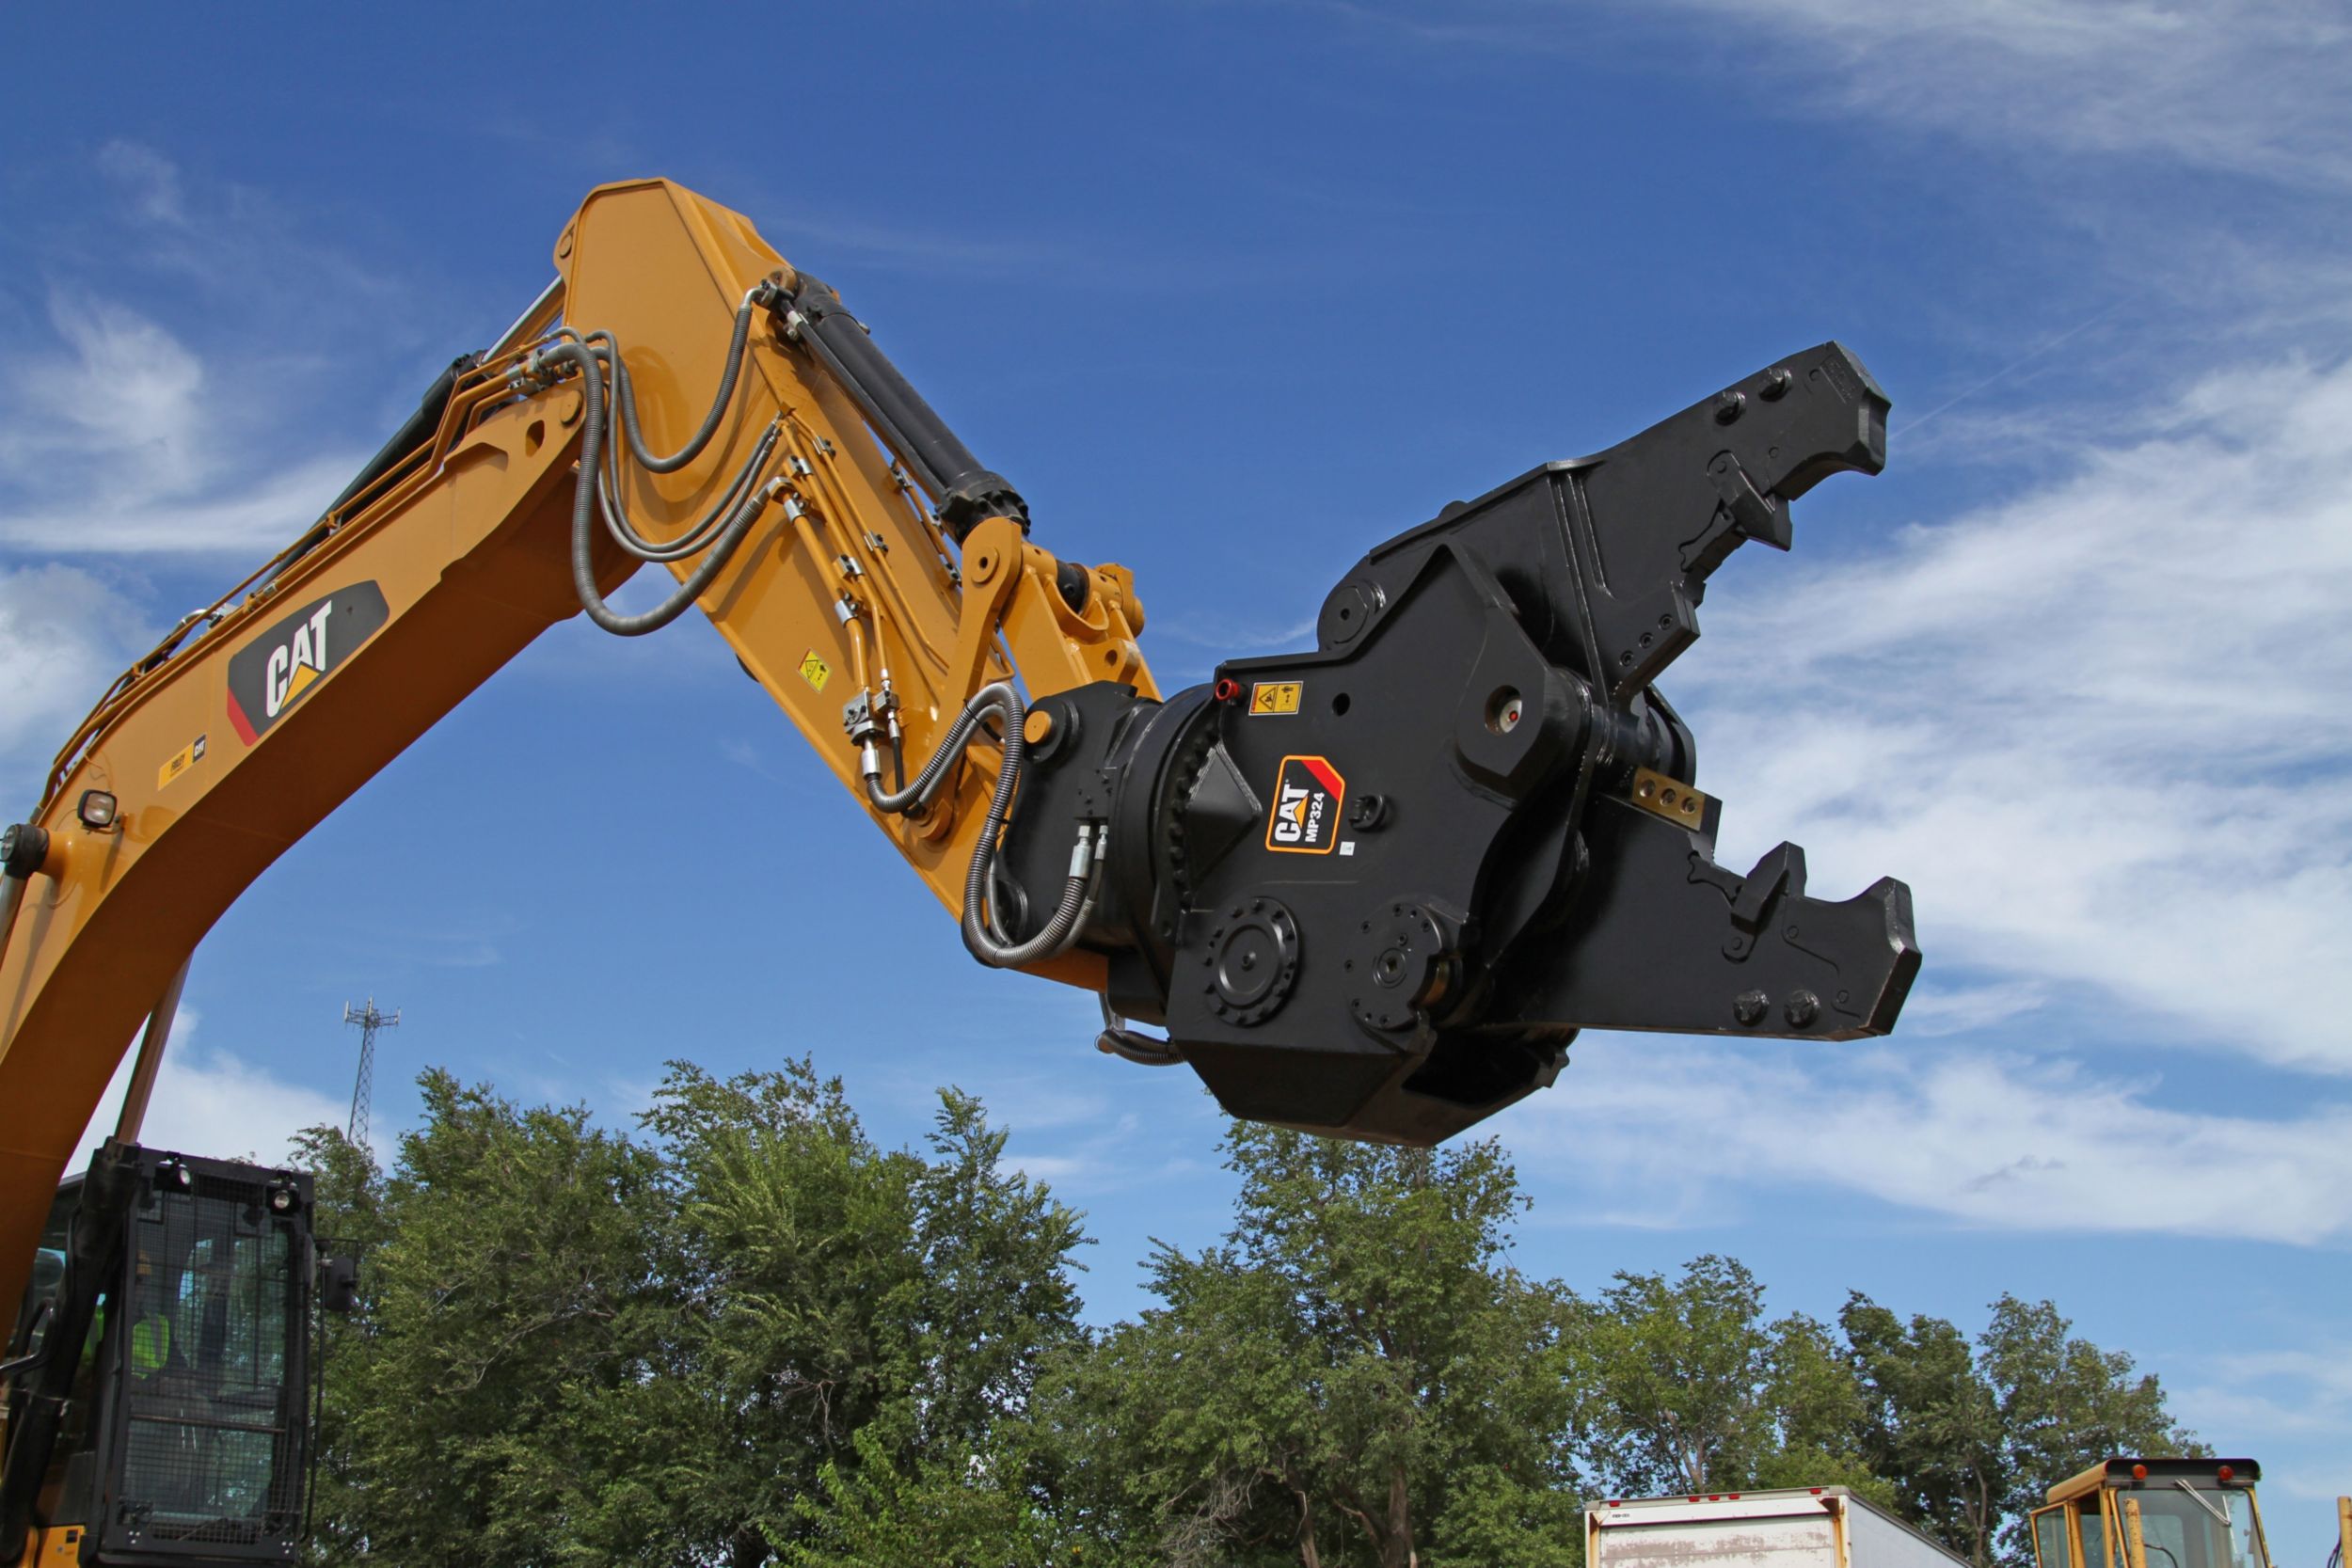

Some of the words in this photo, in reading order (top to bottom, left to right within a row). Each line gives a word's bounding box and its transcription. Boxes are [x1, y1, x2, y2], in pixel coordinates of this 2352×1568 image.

[266, 600, 332, 718] CAT
[195, 739, 205, 757] CAT
[1275, 784, 1310, 842] CAT
[1305, 792, 1325, 842] MP324
